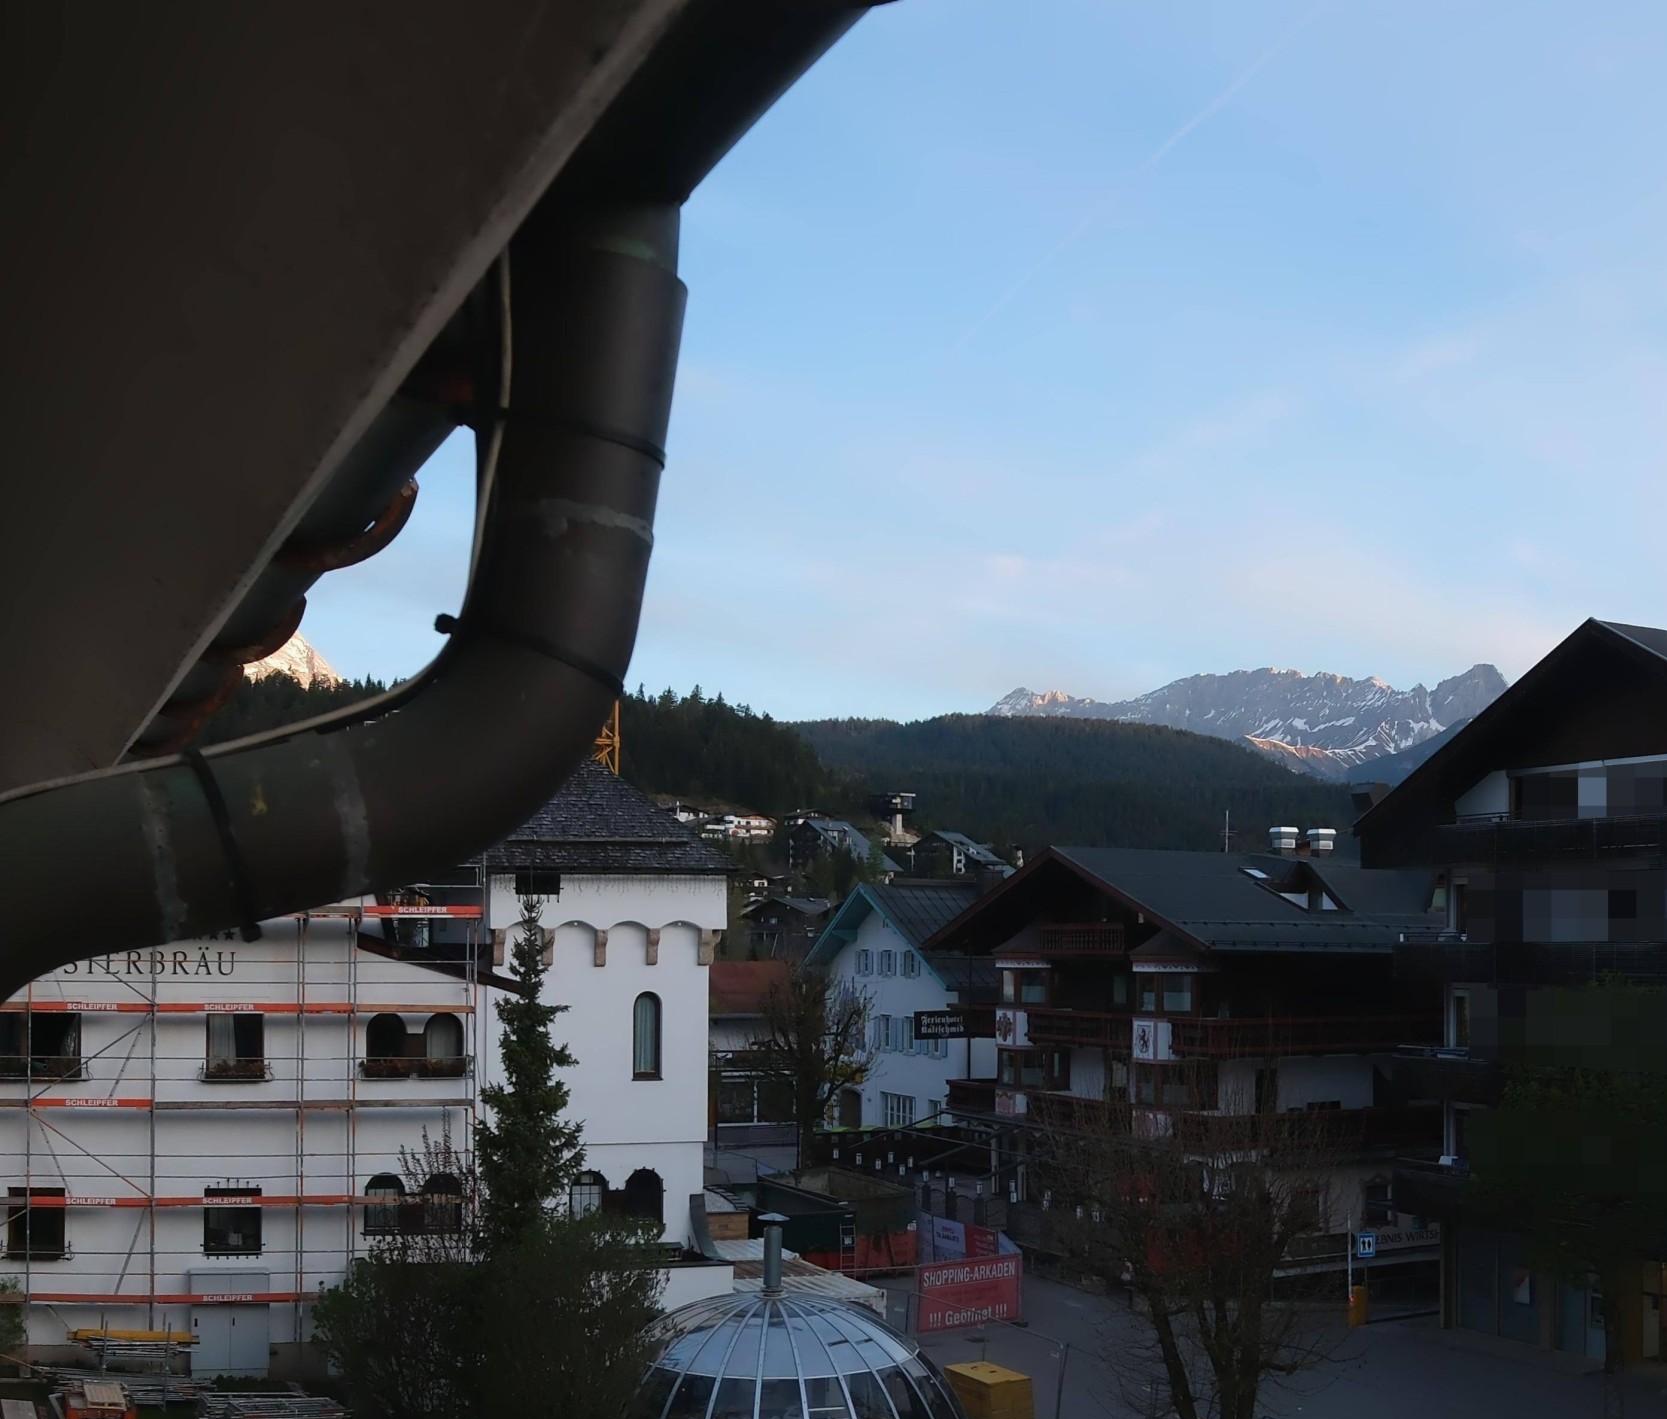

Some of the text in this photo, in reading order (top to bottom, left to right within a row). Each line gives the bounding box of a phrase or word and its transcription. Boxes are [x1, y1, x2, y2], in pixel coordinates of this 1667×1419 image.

[63, 946, 237, 975] STERBRÄU
[65, 1099, 118, 1107] SCHLEIPFER
[1377, 1233, 1402, 1244] EBNIS
[923, 1261, 1015, 1287] SHOPPING-ARKADEN
